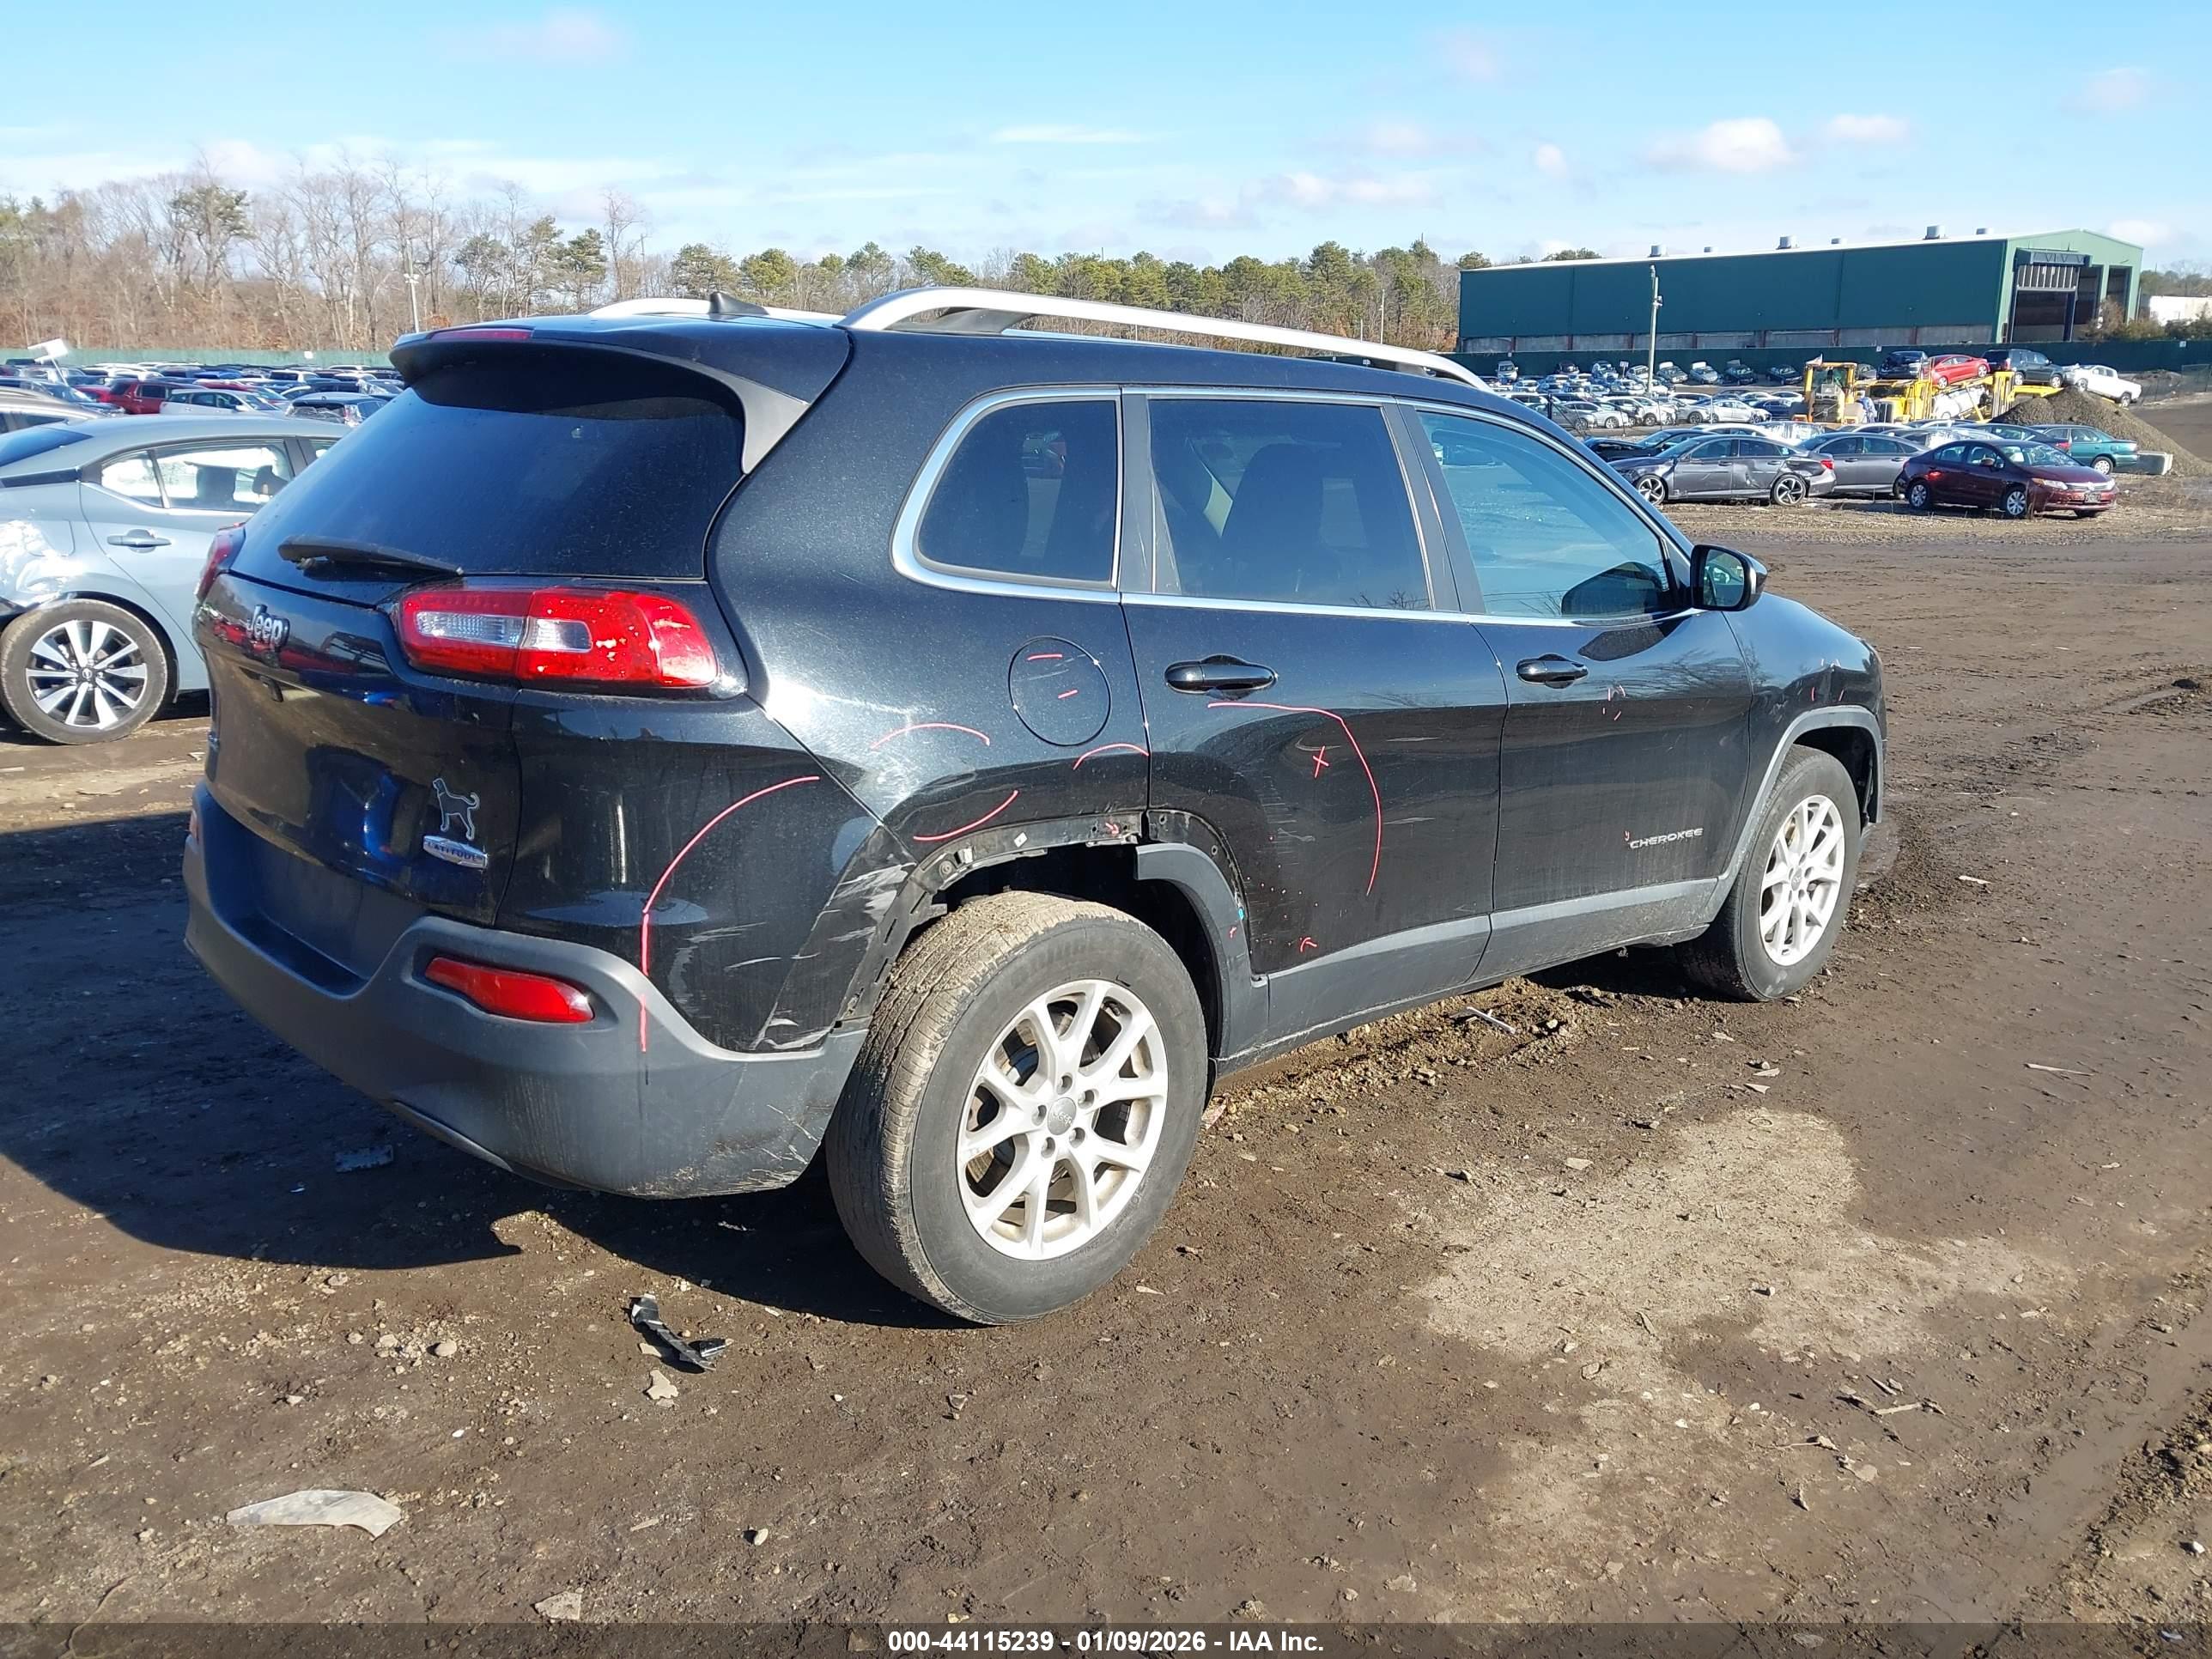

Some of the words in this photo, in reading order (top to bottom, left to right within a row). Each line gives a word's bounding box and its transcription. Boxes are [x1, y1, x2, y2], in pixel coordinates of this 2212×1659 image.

[246, 604, 287, 652] Jeep
[1630, 828, 1704, 849] CHEROKEE
[424, 839, 477, 861] LATITUDE
